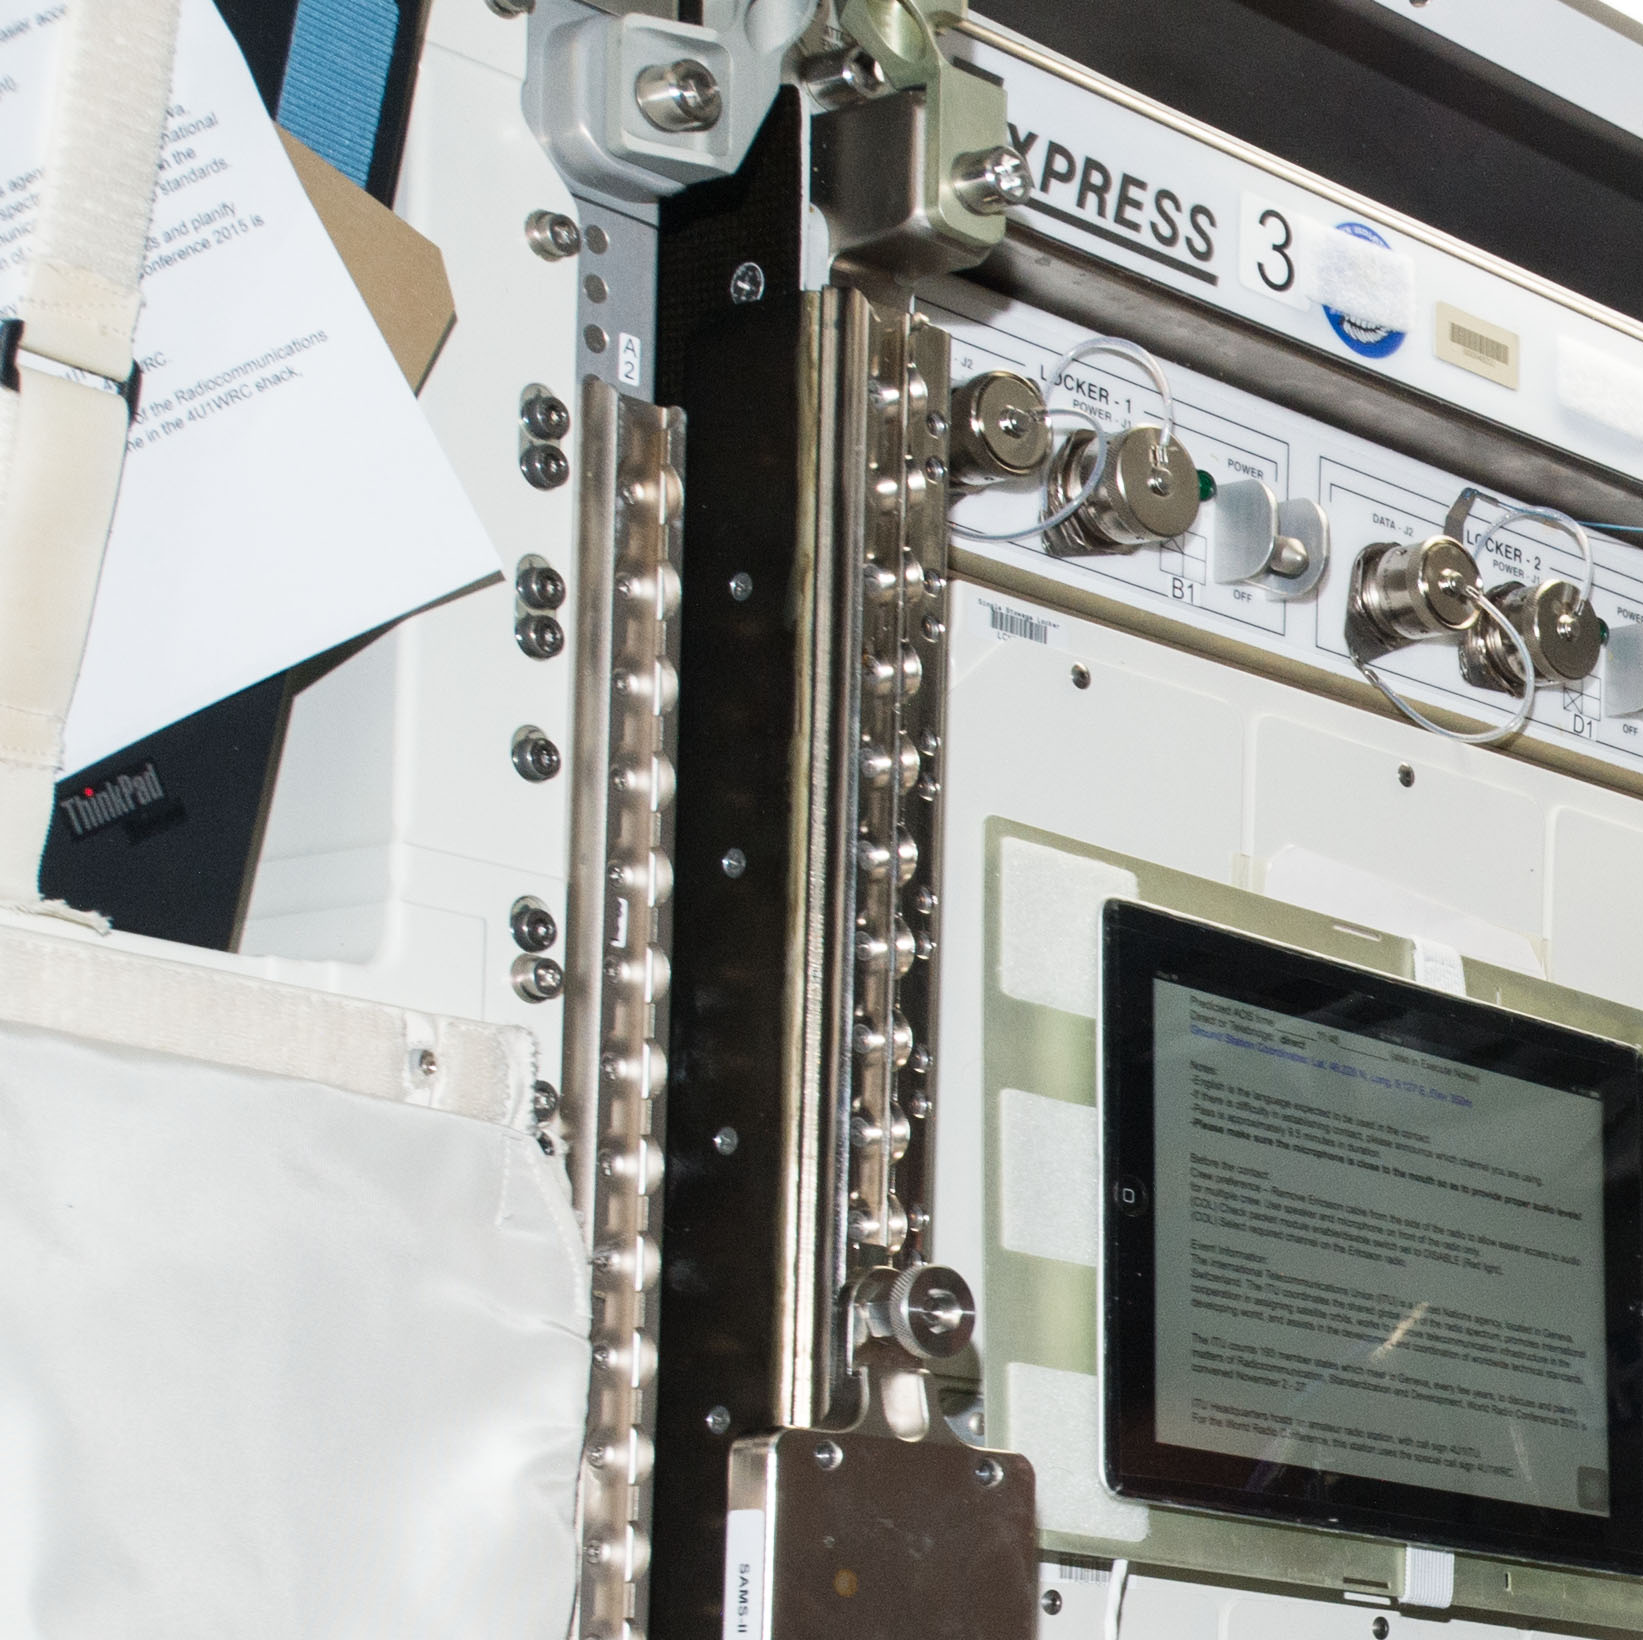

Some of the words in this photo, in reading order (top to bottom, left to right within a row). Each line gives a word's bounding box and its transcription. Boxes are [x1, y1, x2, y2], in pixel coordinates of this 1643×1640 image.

[1007, 122, 1219, 263] XPRESS
[1256, 209, 1295, 293] 3
[162, 221, 189, 245] and
[190, 201, 237, 233] planify
[143, 236, 212, 277] onference
[212, 218, 250, 245] 2015
[624, 338, 638, 359] A
[173, 329, 329, 405] Radiocommunications
[623, 361, 635, 381] 2
[961, 358, 974, 370] J2
[1040, 365, 1110, 406] LOCKER
[186, 383, 253, 423] 4U1WRC
[1073, 399, 1113, 422] POWER
[1227, 457, 1265, 480] POWER
[1372, 512, 1396, 531] DATA
[1466, 530, 1523, 565] LOCKER
[1493, 559, 1525, 577] POWER
[1171, 577, 1196, 603] B1
[1232, 589, 1254, 605] OFF
[1622, 723, 1639, 736] OFF
[61, 761, 164, 836] ThinkPad
[736, 1563, 750, 1633] SAMS-II
